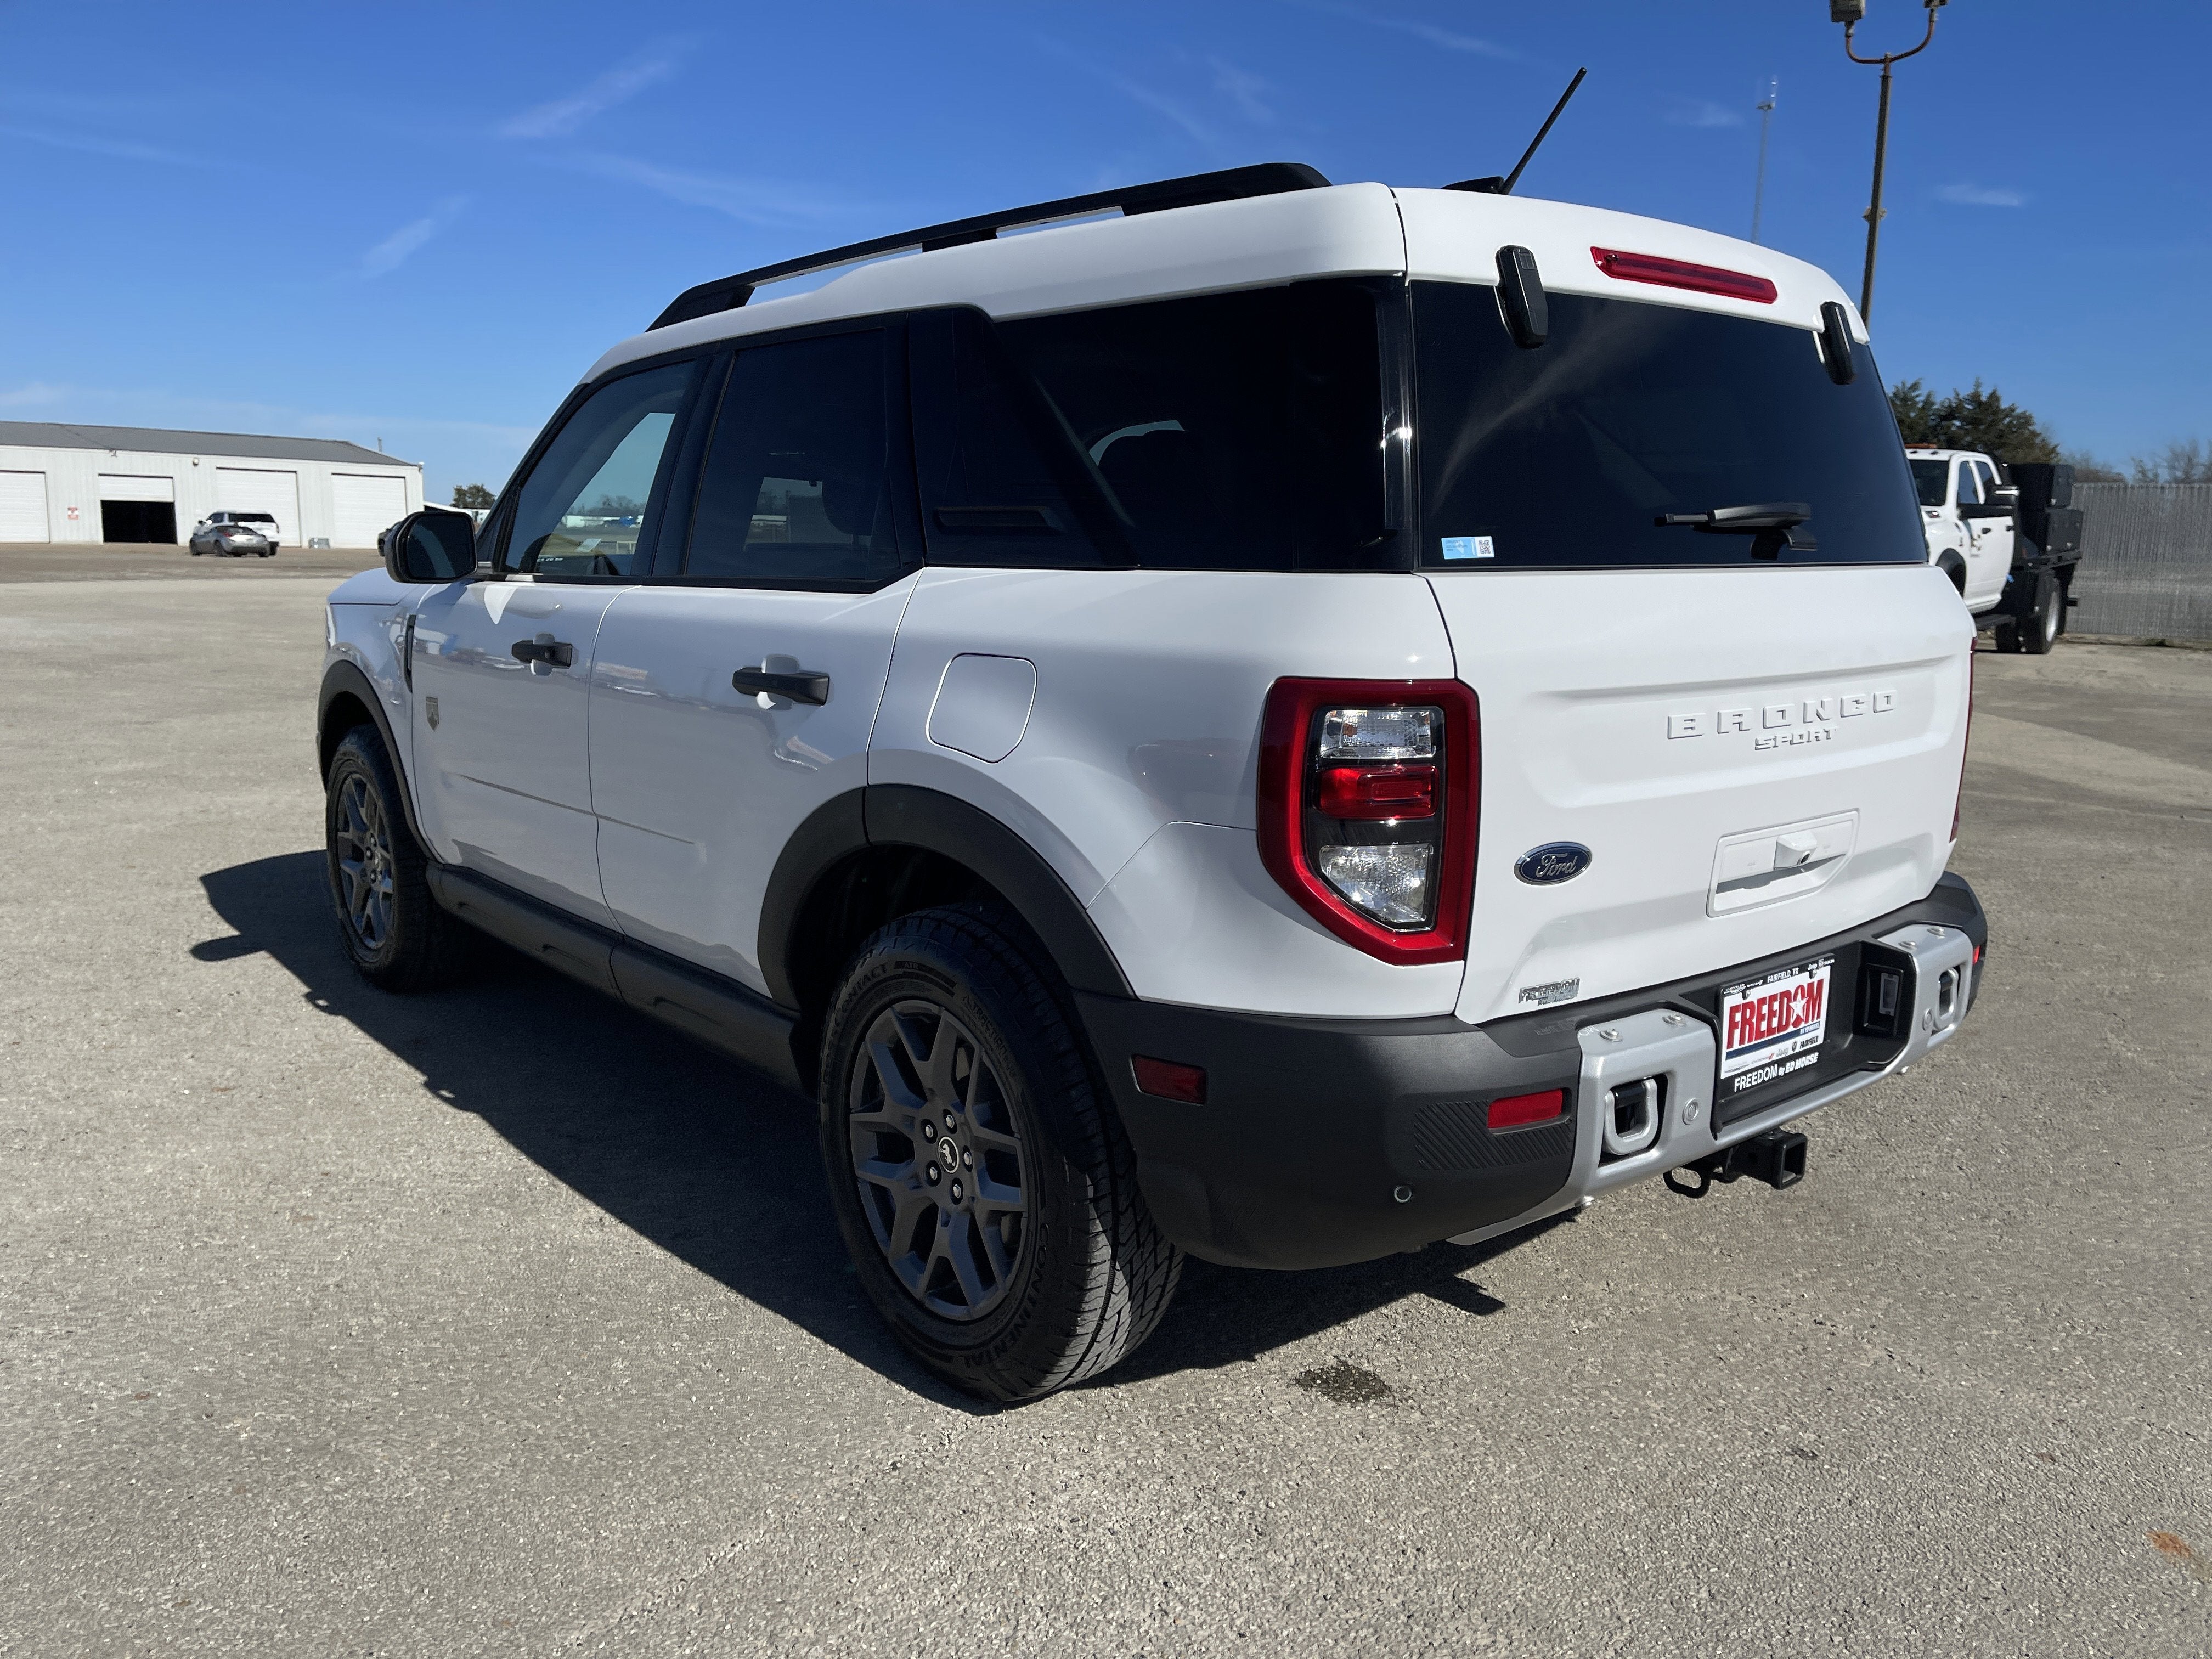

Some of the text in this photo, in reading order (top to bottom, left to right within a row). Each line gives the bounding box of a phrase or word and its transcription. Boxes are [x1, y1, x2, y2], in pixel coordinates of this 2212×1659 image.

[1667, 690, 1897, 740] BRONCO
[1754, 726, 1839, 751] SPORT
[1536, 853, 1578, 878] Ford
[1792, 967, 1799, 976] TX
[1726, 978, 1824, 1050] FREEDOM
[1734, 1064, 1778, 1092] FREEDOM
[1785, 1060, 1795, 1074] ED
[1795, 1052, 1819, 1070] MORSE
